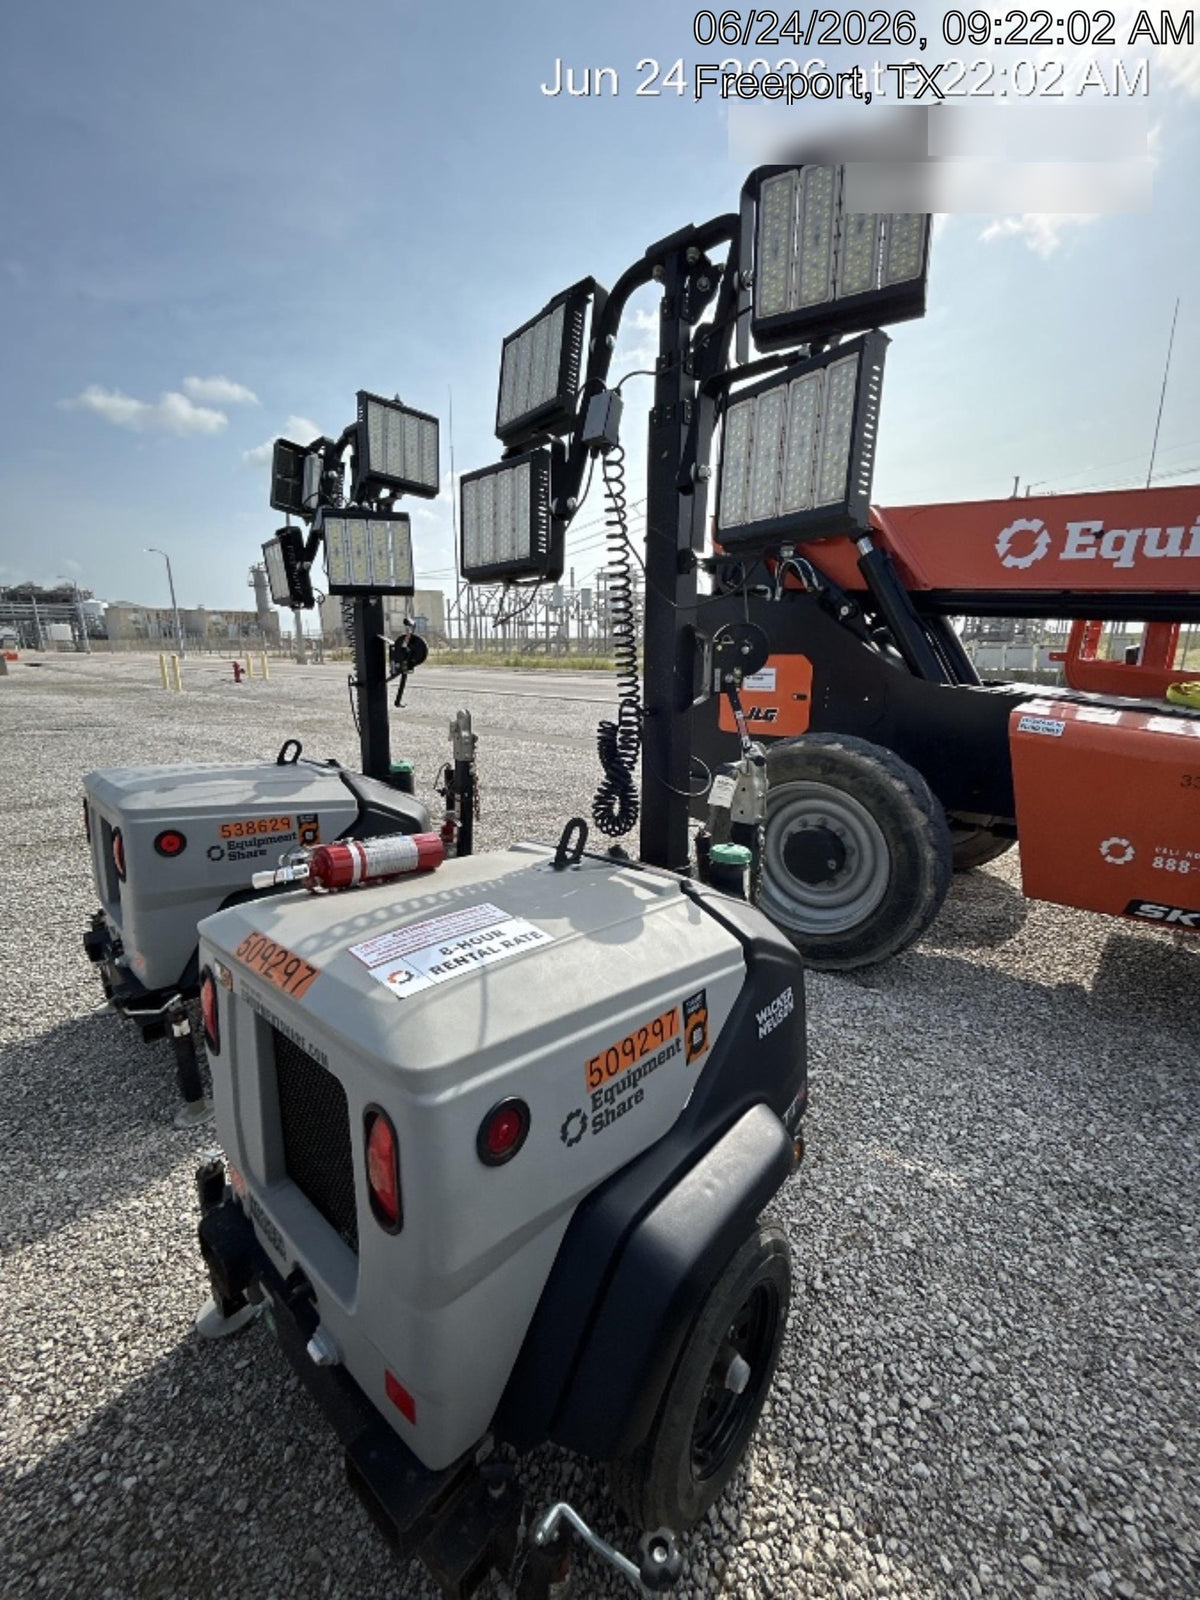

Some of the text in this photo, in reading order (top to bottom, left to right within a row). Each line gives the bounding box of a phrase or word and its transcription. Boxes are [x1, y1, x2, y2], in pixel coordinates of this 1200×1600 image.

[220, 816, 292, 840] 538629
[227, 831, 299, 851] Equipment
[227, 848, 268, 861] Share
[236, 931, 318, 995] 509297
[428, 945, 502, 976] RENTAL
[501, 929, 545, 950] RATE
[587, 1009, 678, 1090] 509297
[589, 1036, 683, 1113] Equipment
[590, 1087, 645, 1136] Share
